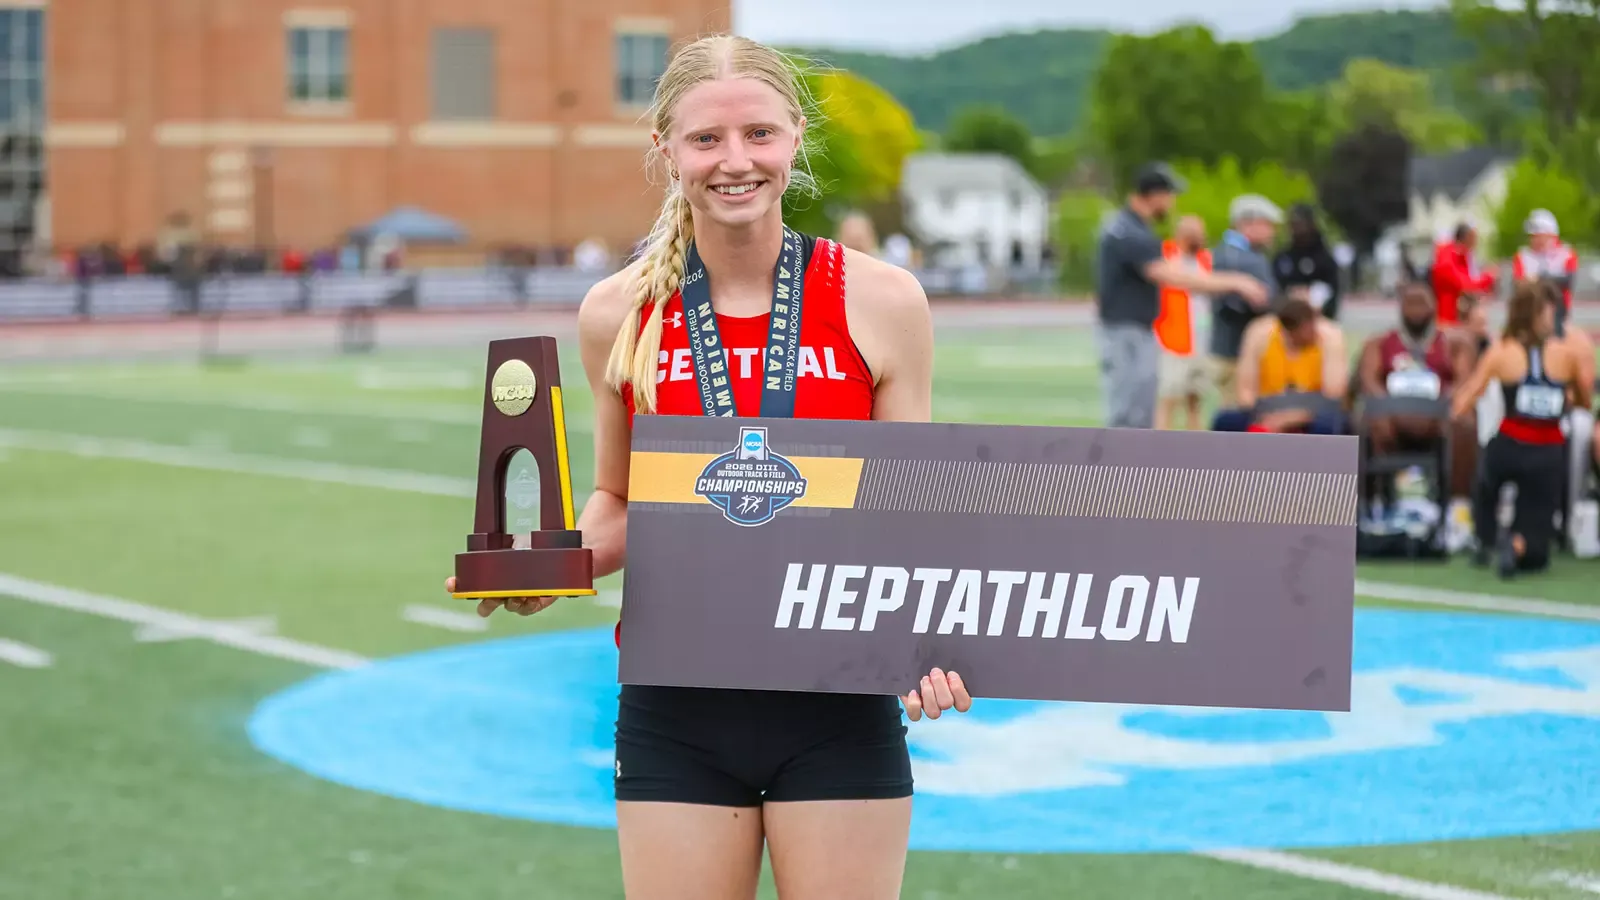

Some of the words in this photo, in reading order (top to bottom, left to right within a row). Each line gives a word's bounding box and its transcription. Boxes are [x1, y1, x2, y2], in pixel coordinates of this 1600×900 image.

[793, 244, 802, 281] DIVISION
[687, 309, 698, 331] FIELD
[789, 289, 801, 334] OUTDOOR
[691, 330, 700, 338] &
[786, 334, 797, 361] TRACK
[692, 337, 704, 365] TRACK
[655, 346, 847, 384] CETAL
[698, 364, 715, 409] OUTDOOR
[783, 368, 794, 392] FIELD
[717, 470, 744, 478] OUTDOOR
[725, 463, 754, 471] 2026
[697, 478, 804, 494] CHAMPIONSHIPS
[774, 563, 1201, 643] HEPTATHLON
